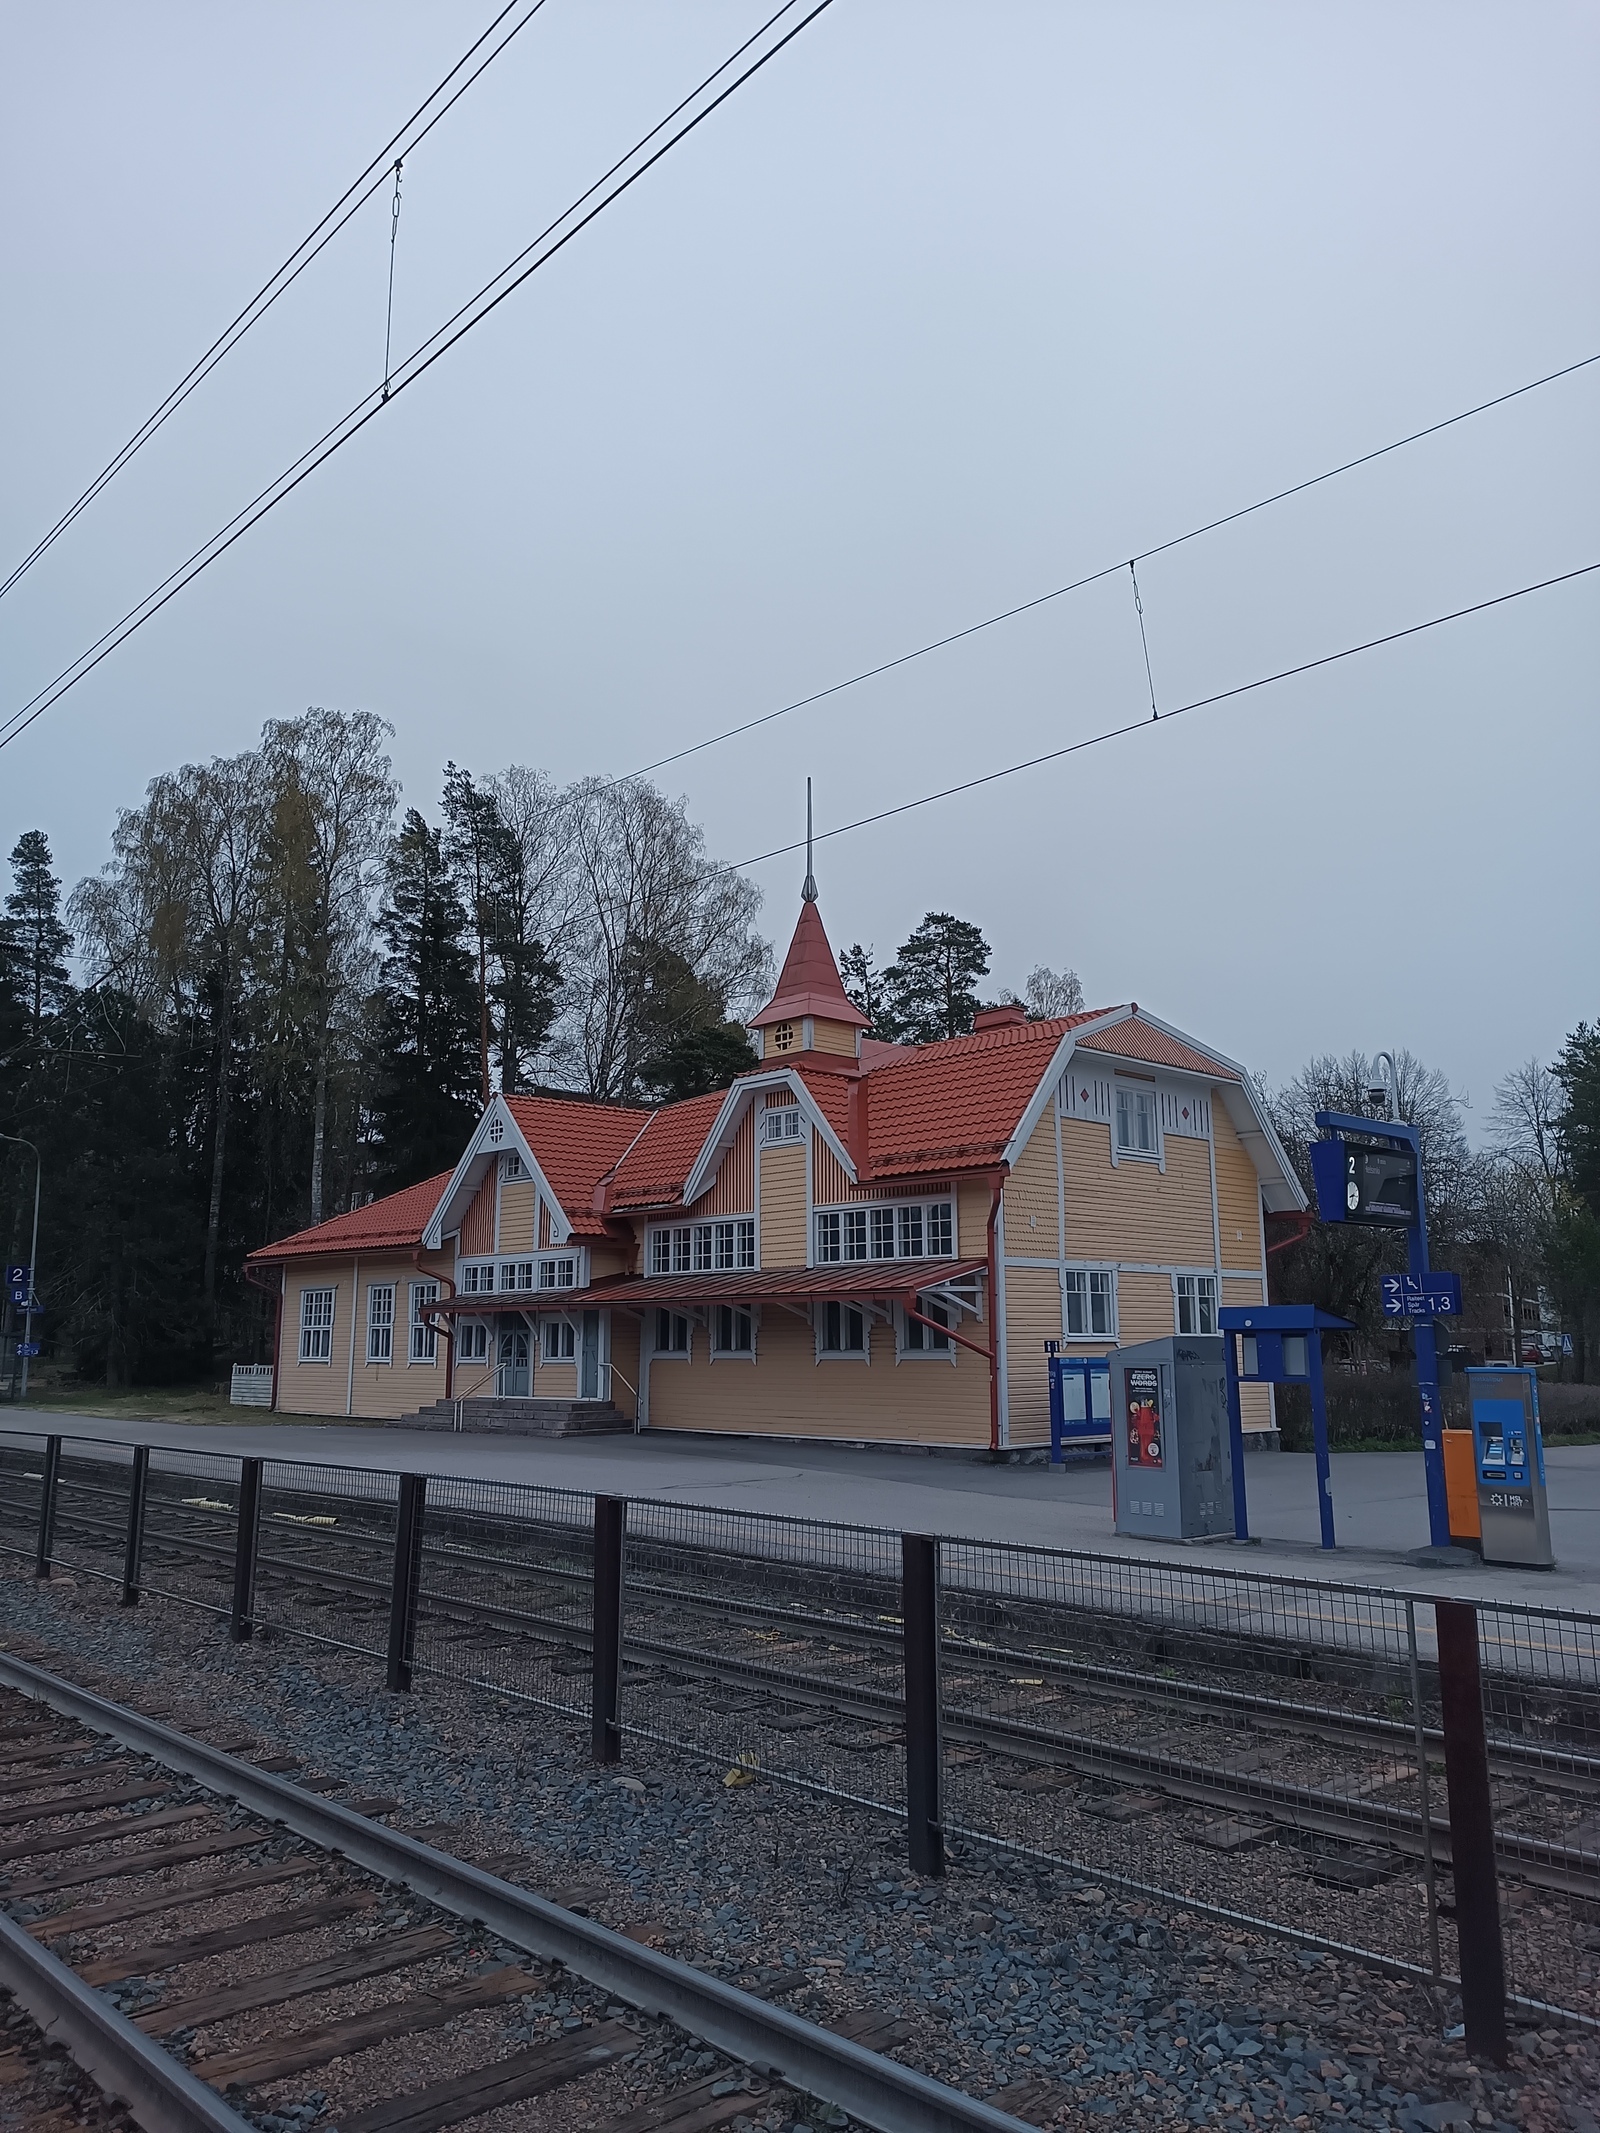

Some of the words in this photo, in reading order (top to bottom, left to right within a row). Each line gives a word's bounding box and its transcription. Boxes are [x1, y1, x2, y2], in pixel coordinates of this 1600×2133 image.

[1348, 1156, 1356, 1174] 2
[12, 1268, 23, 1282] 2
[14, 1291, 23, 1300] B
[1428, 1296, 1451, 1313] 1,3
